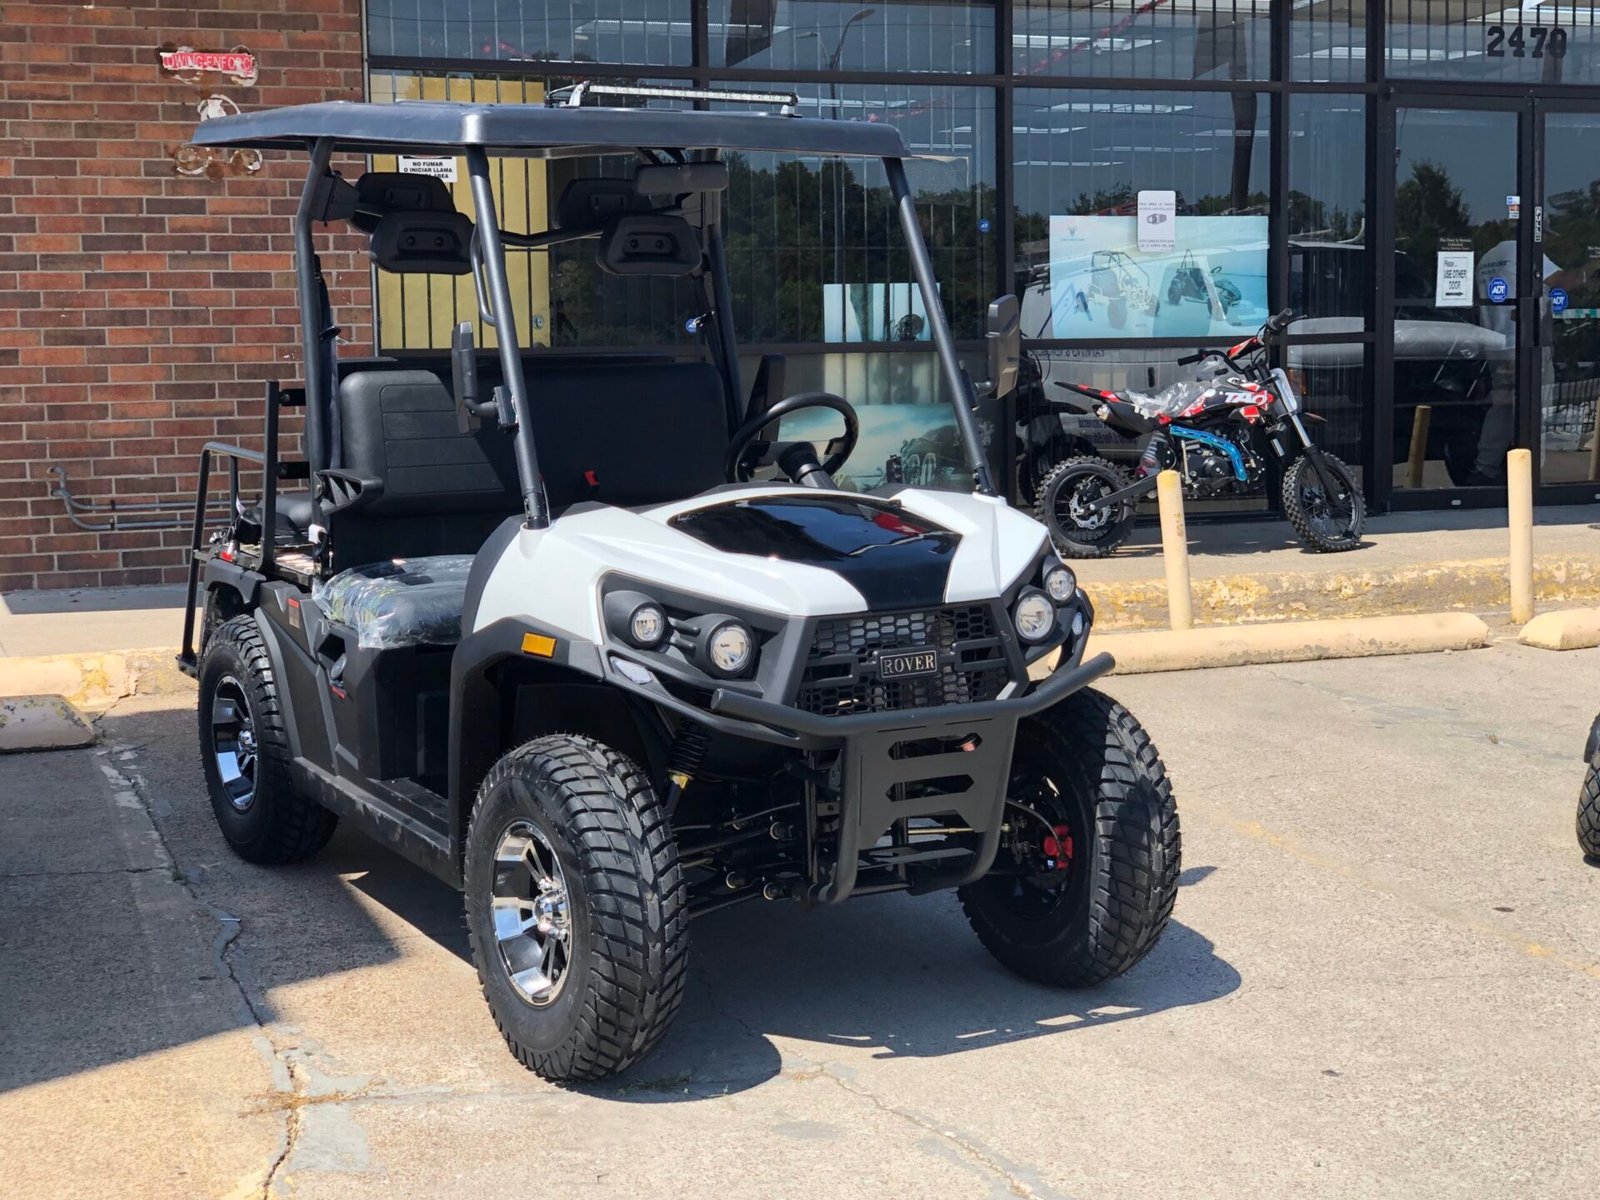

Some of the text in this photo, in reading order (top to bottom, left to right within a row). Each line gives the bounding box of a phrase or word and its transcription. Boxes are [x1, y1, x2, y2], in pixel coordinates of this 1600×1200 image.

[1487, 25, 1567, 58] 2470
[1444, 269, 1467, 279] USE OTHER
[1491, 285, 1506, 295] ADT
[1552, 296, 1565, 306] ADT
[883, 654, 935, 674] ROVER
